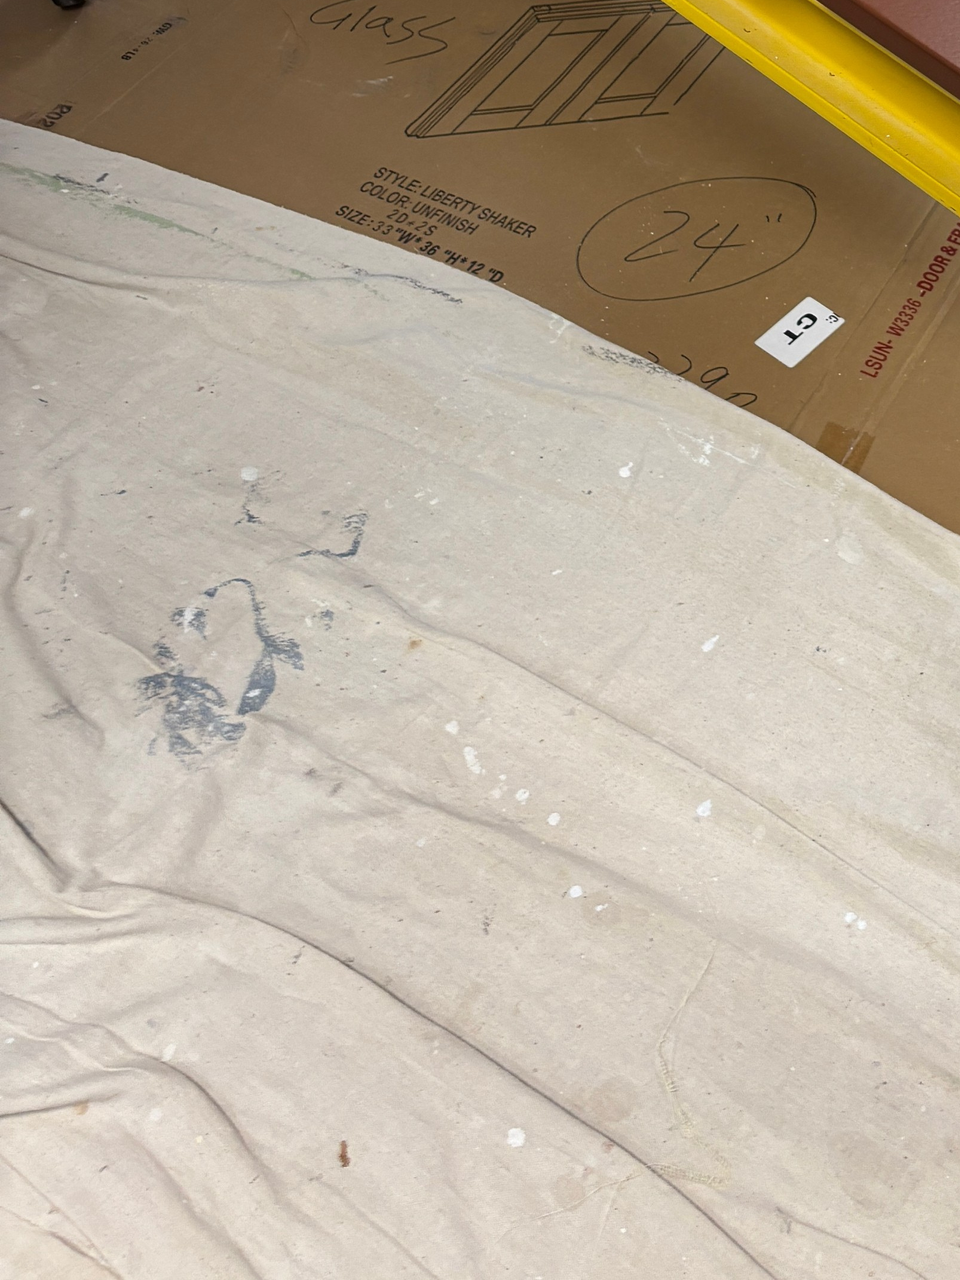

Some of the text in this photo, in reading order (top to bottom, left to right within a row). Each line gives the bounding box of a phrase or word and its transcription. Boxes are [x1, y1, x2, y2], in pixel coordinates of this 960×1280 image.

[359, 180, 480, 236] COLOR: UNFINISH
[373, 166, 537, 239] STYLE: LIBERTY SHAKER
[783, 312, 818, 346] CT
[859, 339, 894, 379] LSUN-
[886, 297, 922, 337] W3336
[940, 245, 959, 257] &
